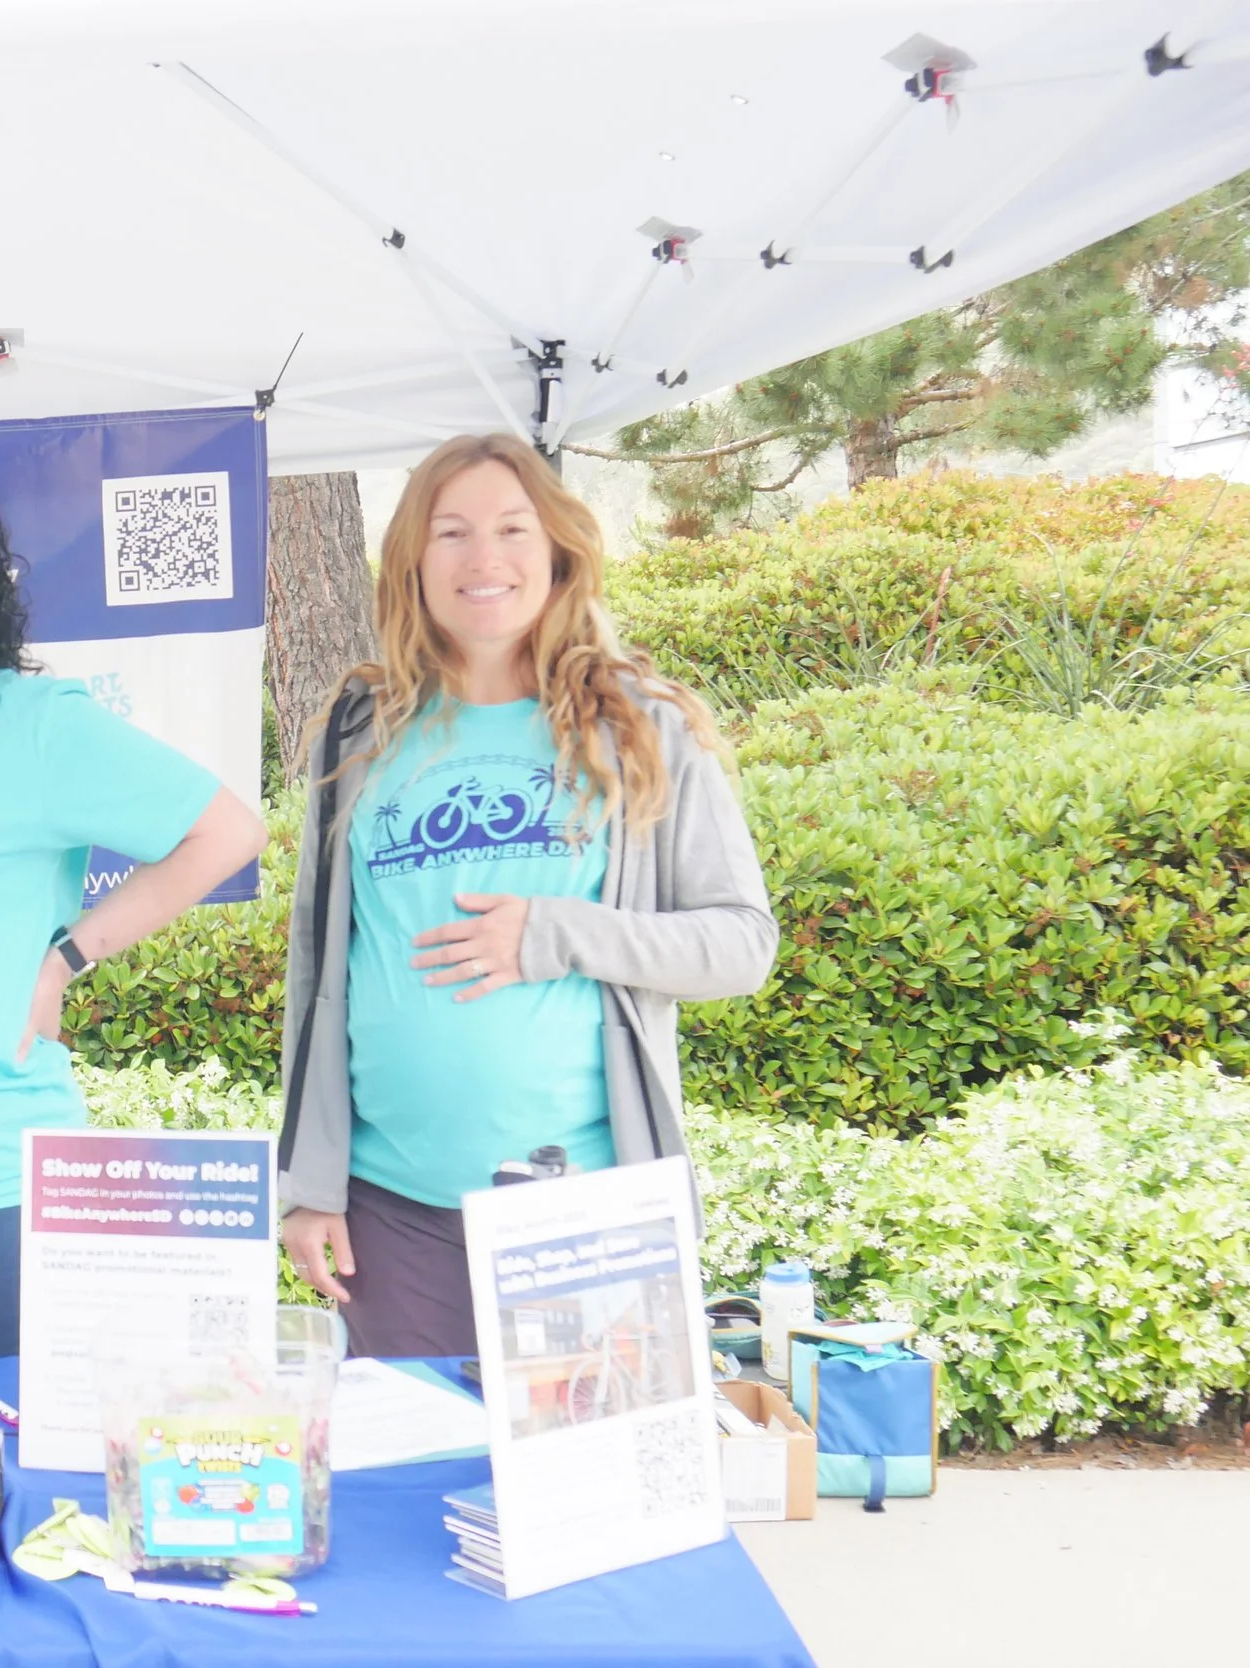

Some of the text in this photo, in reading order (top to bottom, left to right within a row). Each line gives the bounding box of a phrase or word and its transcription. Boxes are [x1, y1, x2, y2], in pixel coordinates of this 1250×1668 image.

[369, 857, 417, 880] BIKE
[421, 841, 546, 871] ANYWHERE
[41, 1158, 259, 1183] Show Off Your Ride!
[60, 1187, 99, 1199] SANDAG
[174, 1442, 265, 1468] PUNCH
